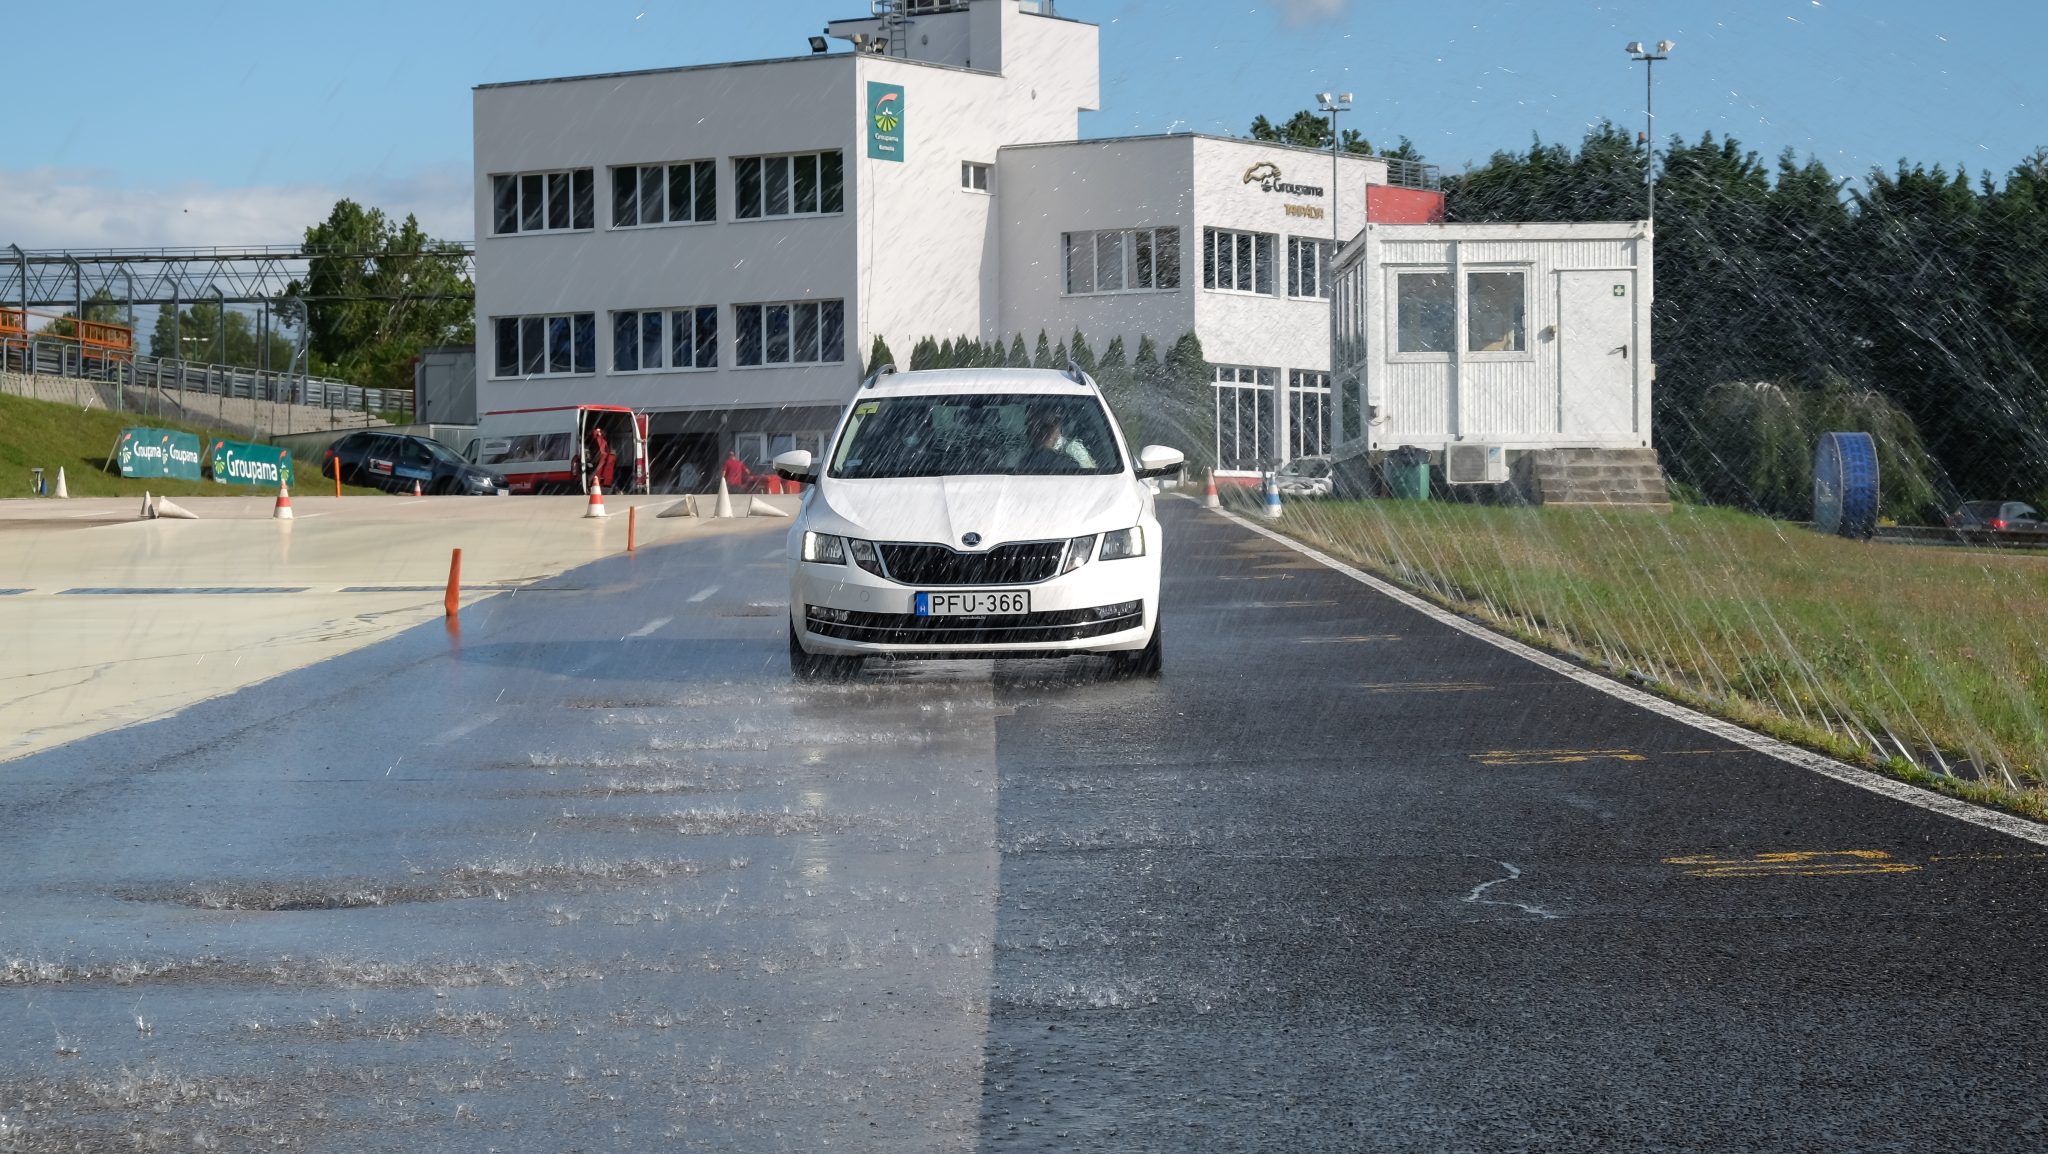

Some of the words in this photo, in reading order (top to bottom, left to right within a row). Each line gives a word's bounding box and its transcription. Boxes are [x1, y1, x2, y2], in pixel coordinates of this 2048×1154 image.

[1273, 177, 1324, 197] Groupama
[226, 449, 278, 485] Groupama
[932, 594, 1024, 613] PFU-366
